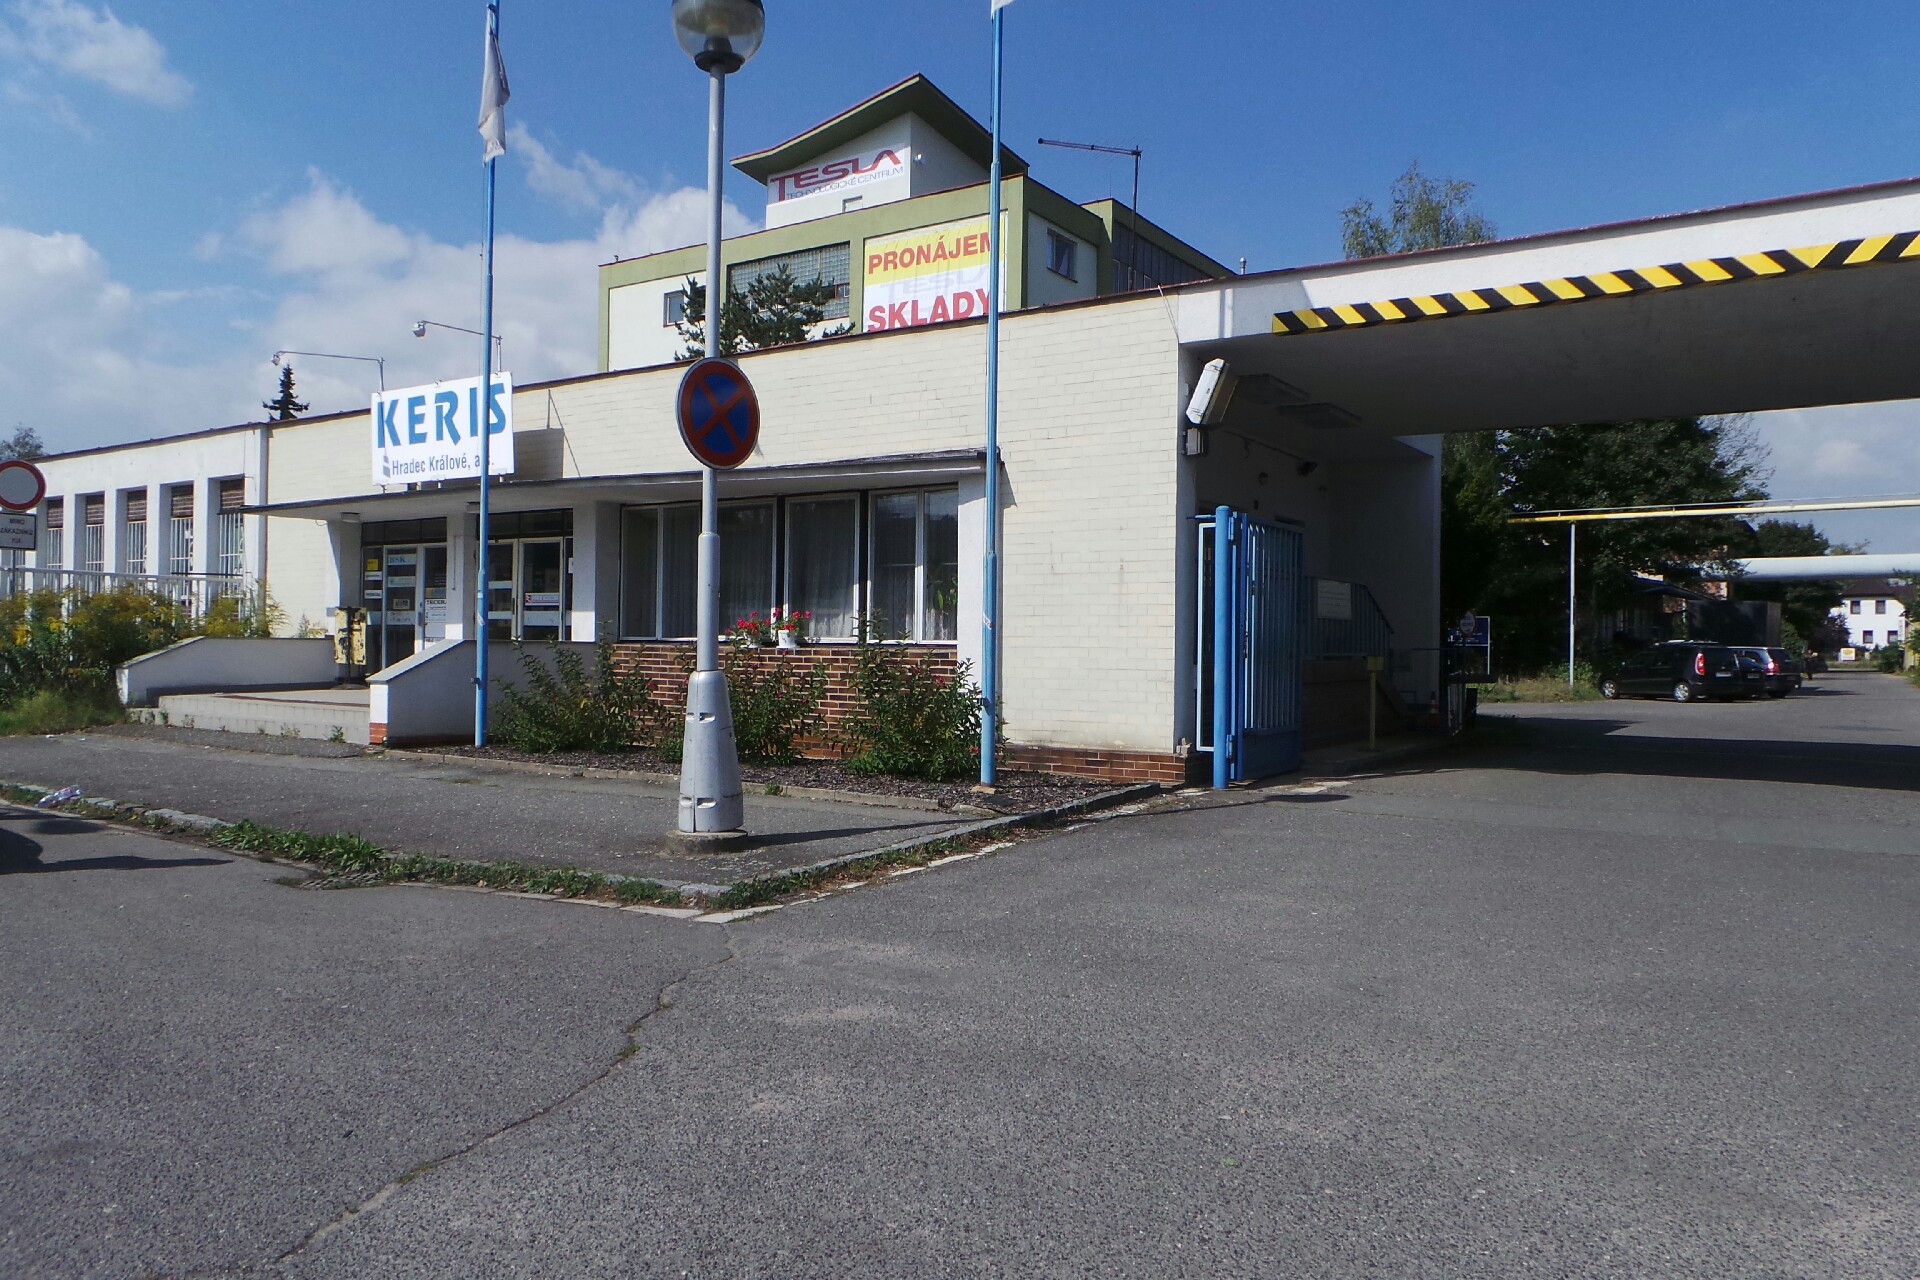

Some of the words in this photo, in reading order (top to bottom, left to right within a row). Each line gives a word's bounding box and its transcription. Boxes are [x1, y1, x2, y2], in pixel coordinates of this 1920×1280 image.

[770, 149, 902, 202] TESLA
[786, 176, 856, 200] TECHNOLOGICKÉ
[857, 166, 904, 184] CENTRUM
[377, 383, 506, 449] KERIS
[392, 458, 426, 475] Hradec
[429, 453, 470, 471] Králové,
